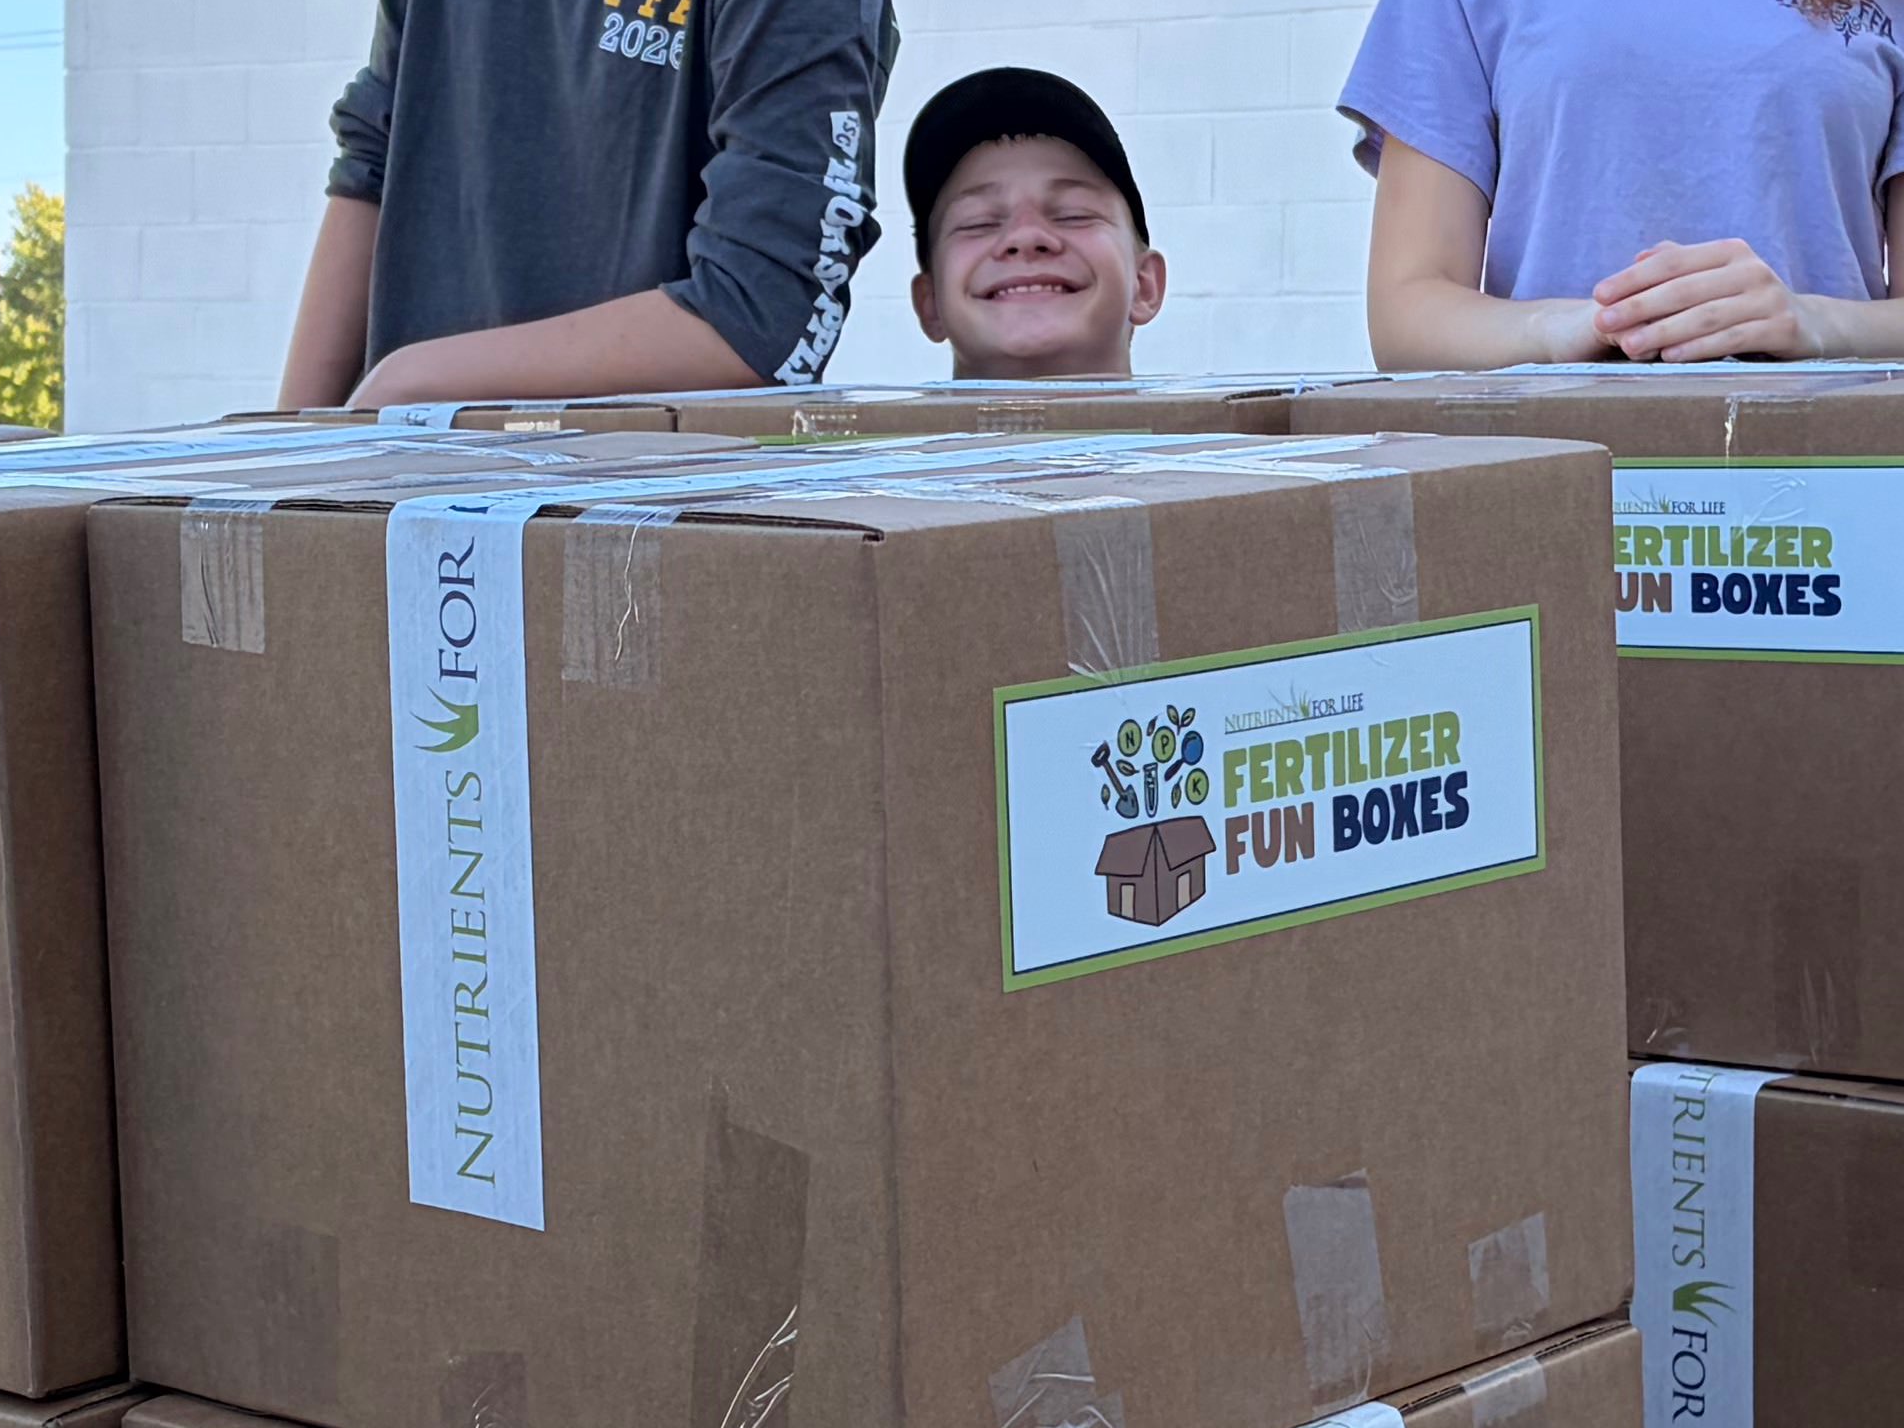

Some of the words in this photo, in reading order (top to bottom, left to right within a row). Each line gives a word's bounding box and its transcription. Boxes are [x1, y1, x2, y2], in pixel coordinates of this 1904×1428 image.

[1613, 524, 1833, 568] ERTILIZER
[1614, 572, 1673, 614] UN
[1691, 572, 1842, 617] BOXES
[437, 535, 479, 684] FOR
[1224, 705, 1297, 733] NUTRIENTS
[1312, 698, 1338, 719] FOR
[1341, 692, 1365, 713] LIFE
[1224, 710, 1462, 808] FERTILIZER
[1225, 802, 1315, 875] FUN
[1333, 770, 1470, 853] BOXES
[444, 768, 497, 1185] NUTRIENTS
[1671, 1070, 1707, 1270] TRIENTS
[1671, 1324, 1709, 1423] FOR
